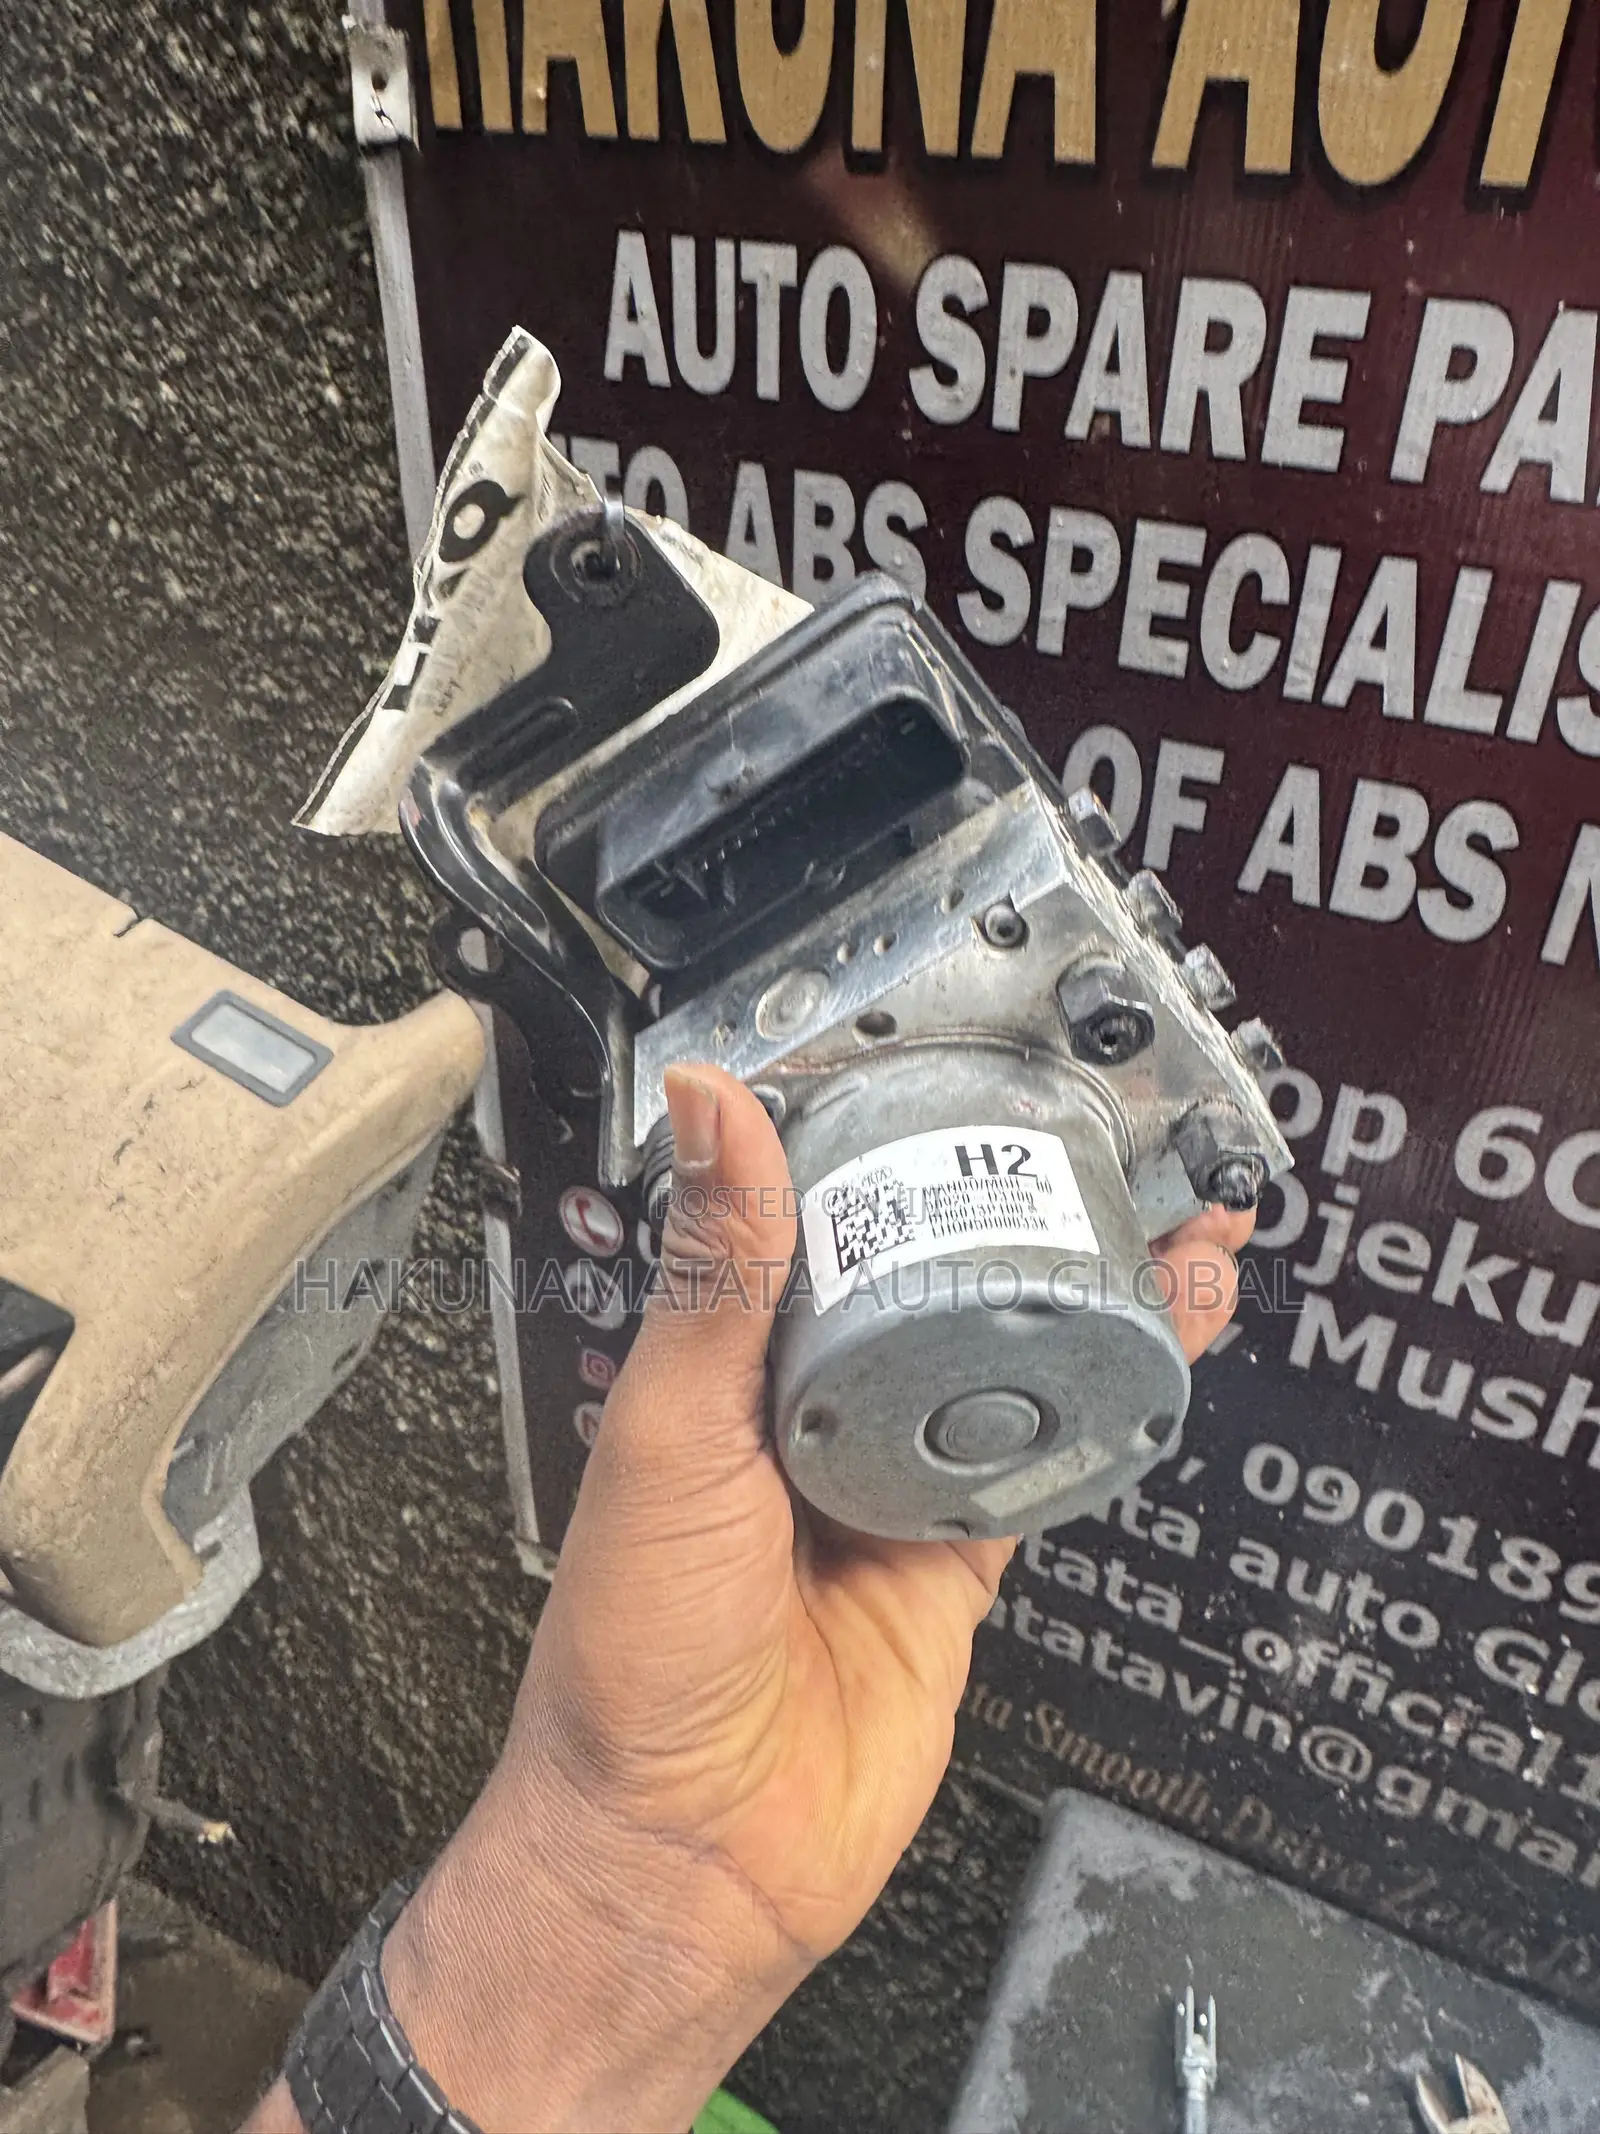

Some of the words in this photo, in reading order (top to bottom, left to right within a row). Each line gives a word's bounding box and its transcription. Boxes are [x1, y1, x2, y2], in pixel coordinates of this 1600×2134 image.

[604, 229, 878, 412] AUTO
[908, 253, 1372, 473] SPARE
[1389, 297, 1600, 505] PA
[724, 460, 928, 605] ABS
[1062, 724, 1226, 871] OF
[1236, 762, 1520, 943] ABS
[955, 1144, 1037, 1178] H2
[1094, 1487, 1201, 1559] ta
[1229, 1536, 1441, 1650] auto
